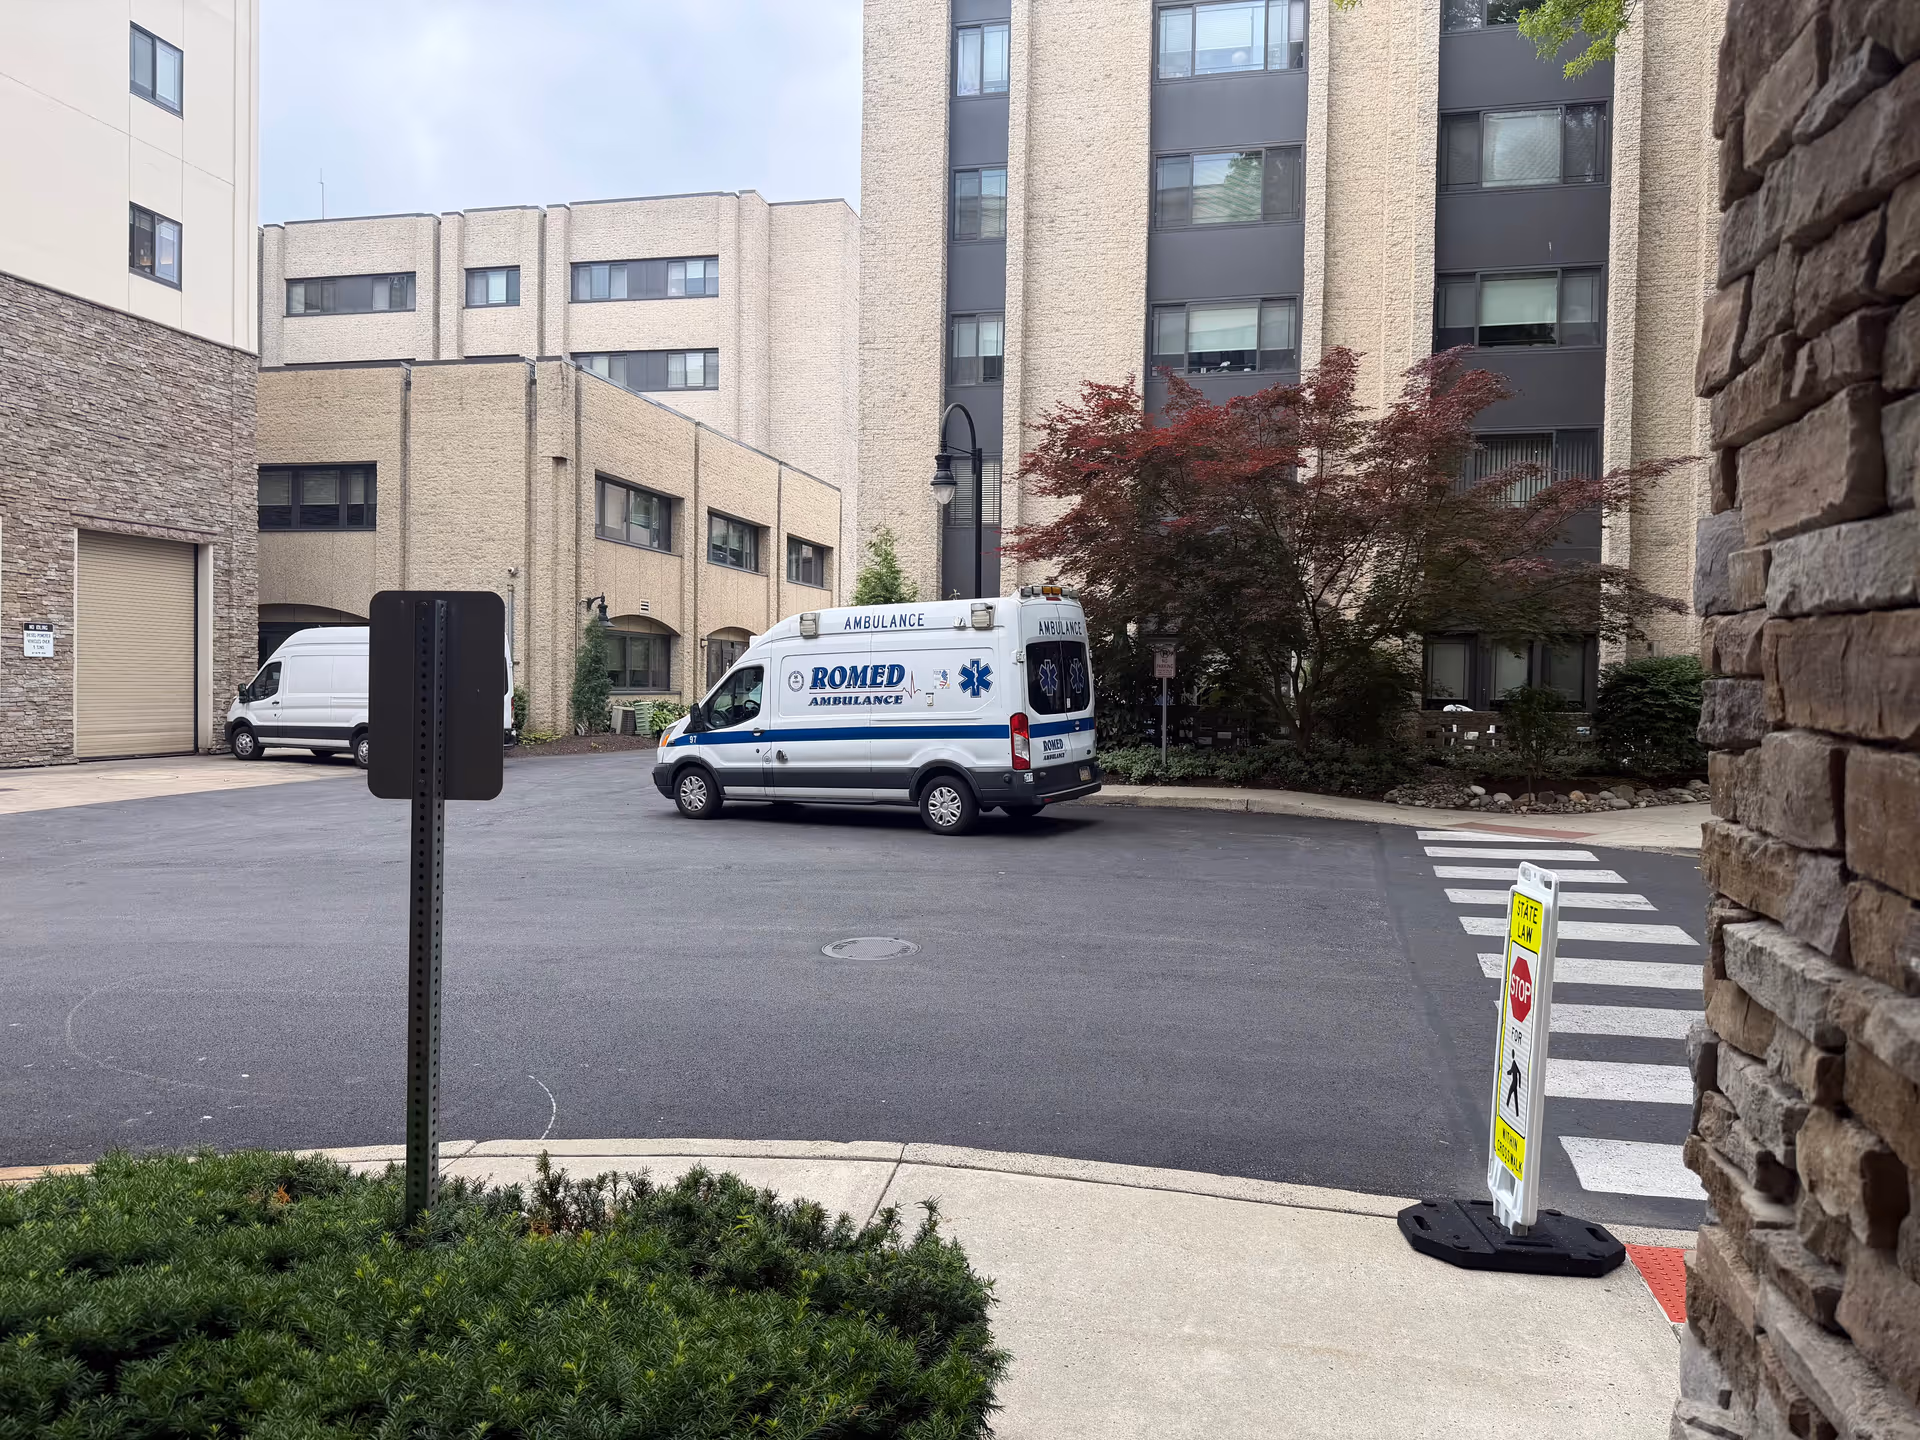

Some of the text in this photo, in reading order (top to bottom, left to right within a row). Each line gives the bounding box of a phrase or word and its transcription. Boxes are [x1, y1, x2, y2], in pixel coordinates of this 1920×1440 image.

[844, 613, 925, 630] AMBULANCE
[1038, 620, 1083, 636] AMBULANCE
[809, 664, 905, 690] ROMED
[808, 695, 903, 706] AMBULANCE
[689, 735, 697, 744] 97
[1043, 739, 1064, 752] ROMED
[1043, 752, 1065, 761] AMBULANCE
[1517, 900, 1538, 925] STATE
[1517, 921, 1533, 944] LAW
[1511, 973, 1531, 1004] STOP
[1511, 1026, 1523, 1046] FOR
[1502, 1127, 1518, 1152] WITHIN
[1497, 1138, 1523, 1175] CROSSWALK
